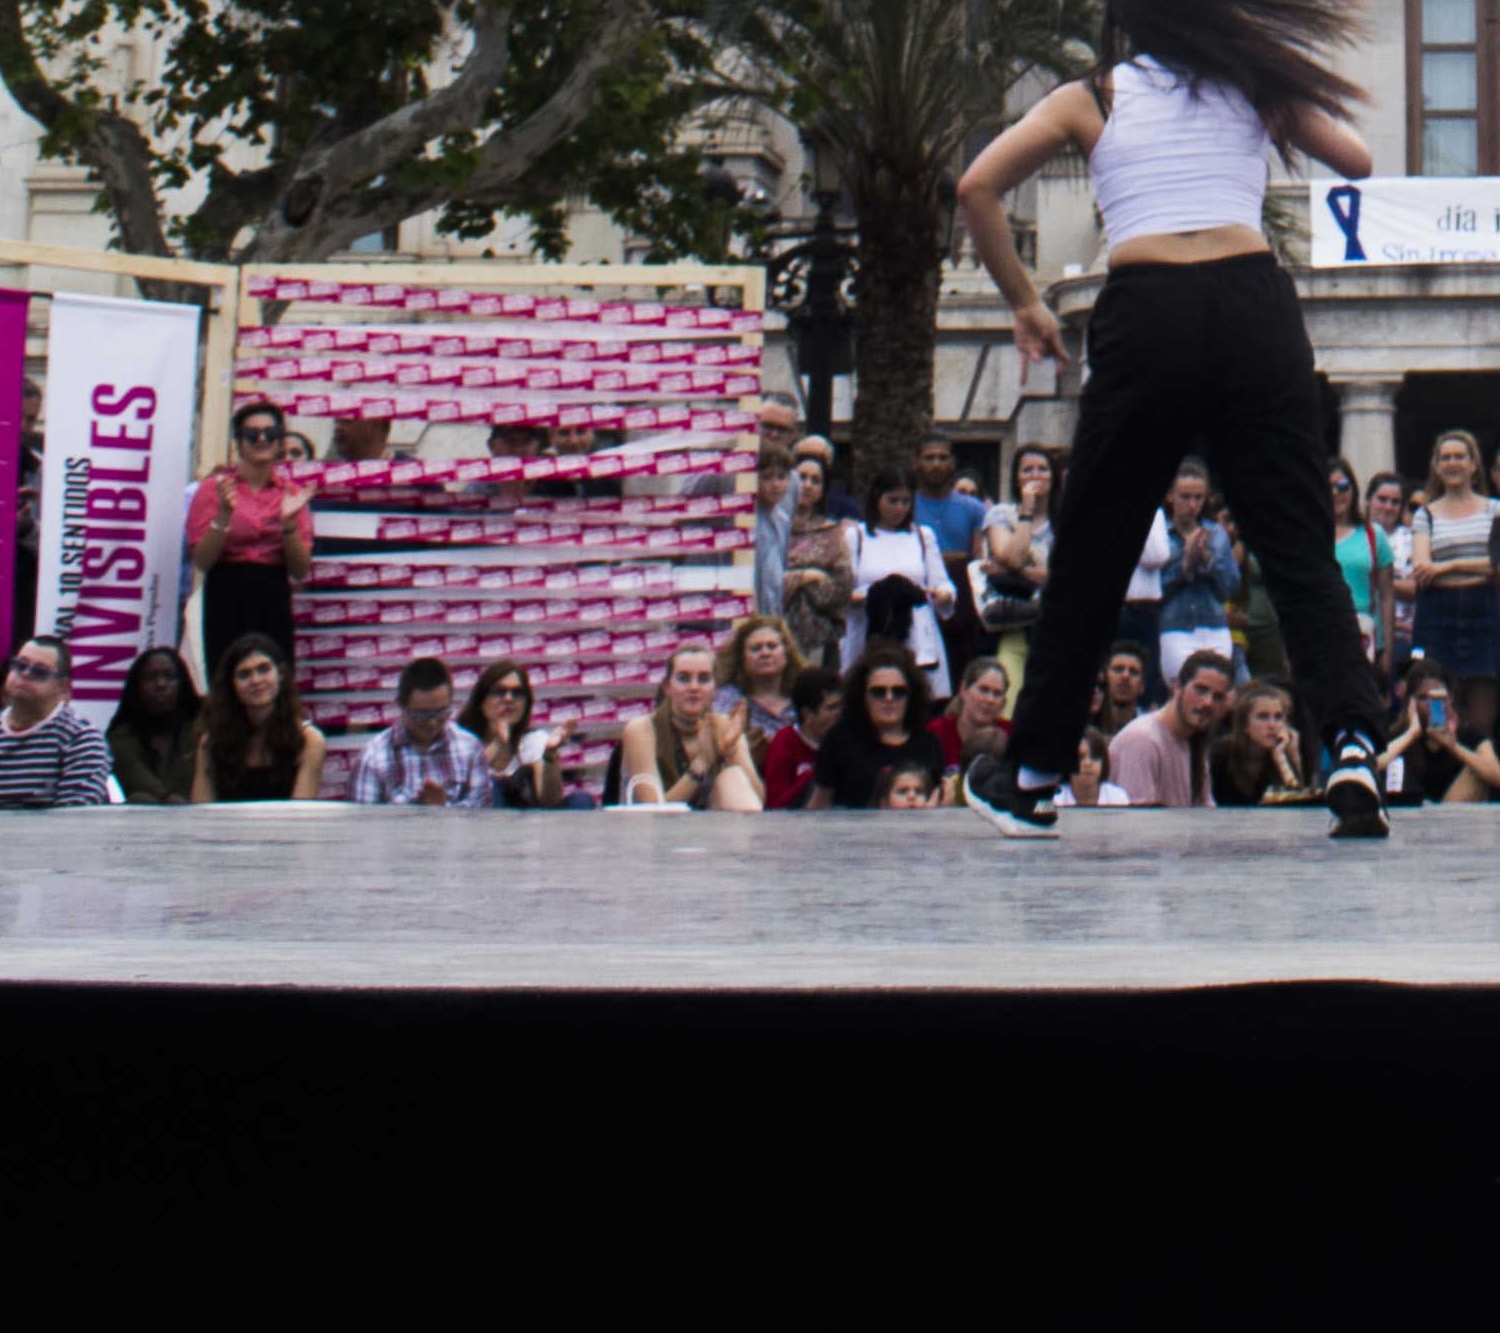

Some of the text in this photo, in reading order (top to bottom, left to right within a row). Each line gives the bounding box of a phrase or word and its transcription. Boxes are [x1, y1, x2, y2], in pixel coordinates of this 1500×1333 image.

[1436, 205, 1478, 233] día
[59, 457, 92, 567] SENTIDOS
[70, 383, 158, 701] INVISIBLES
